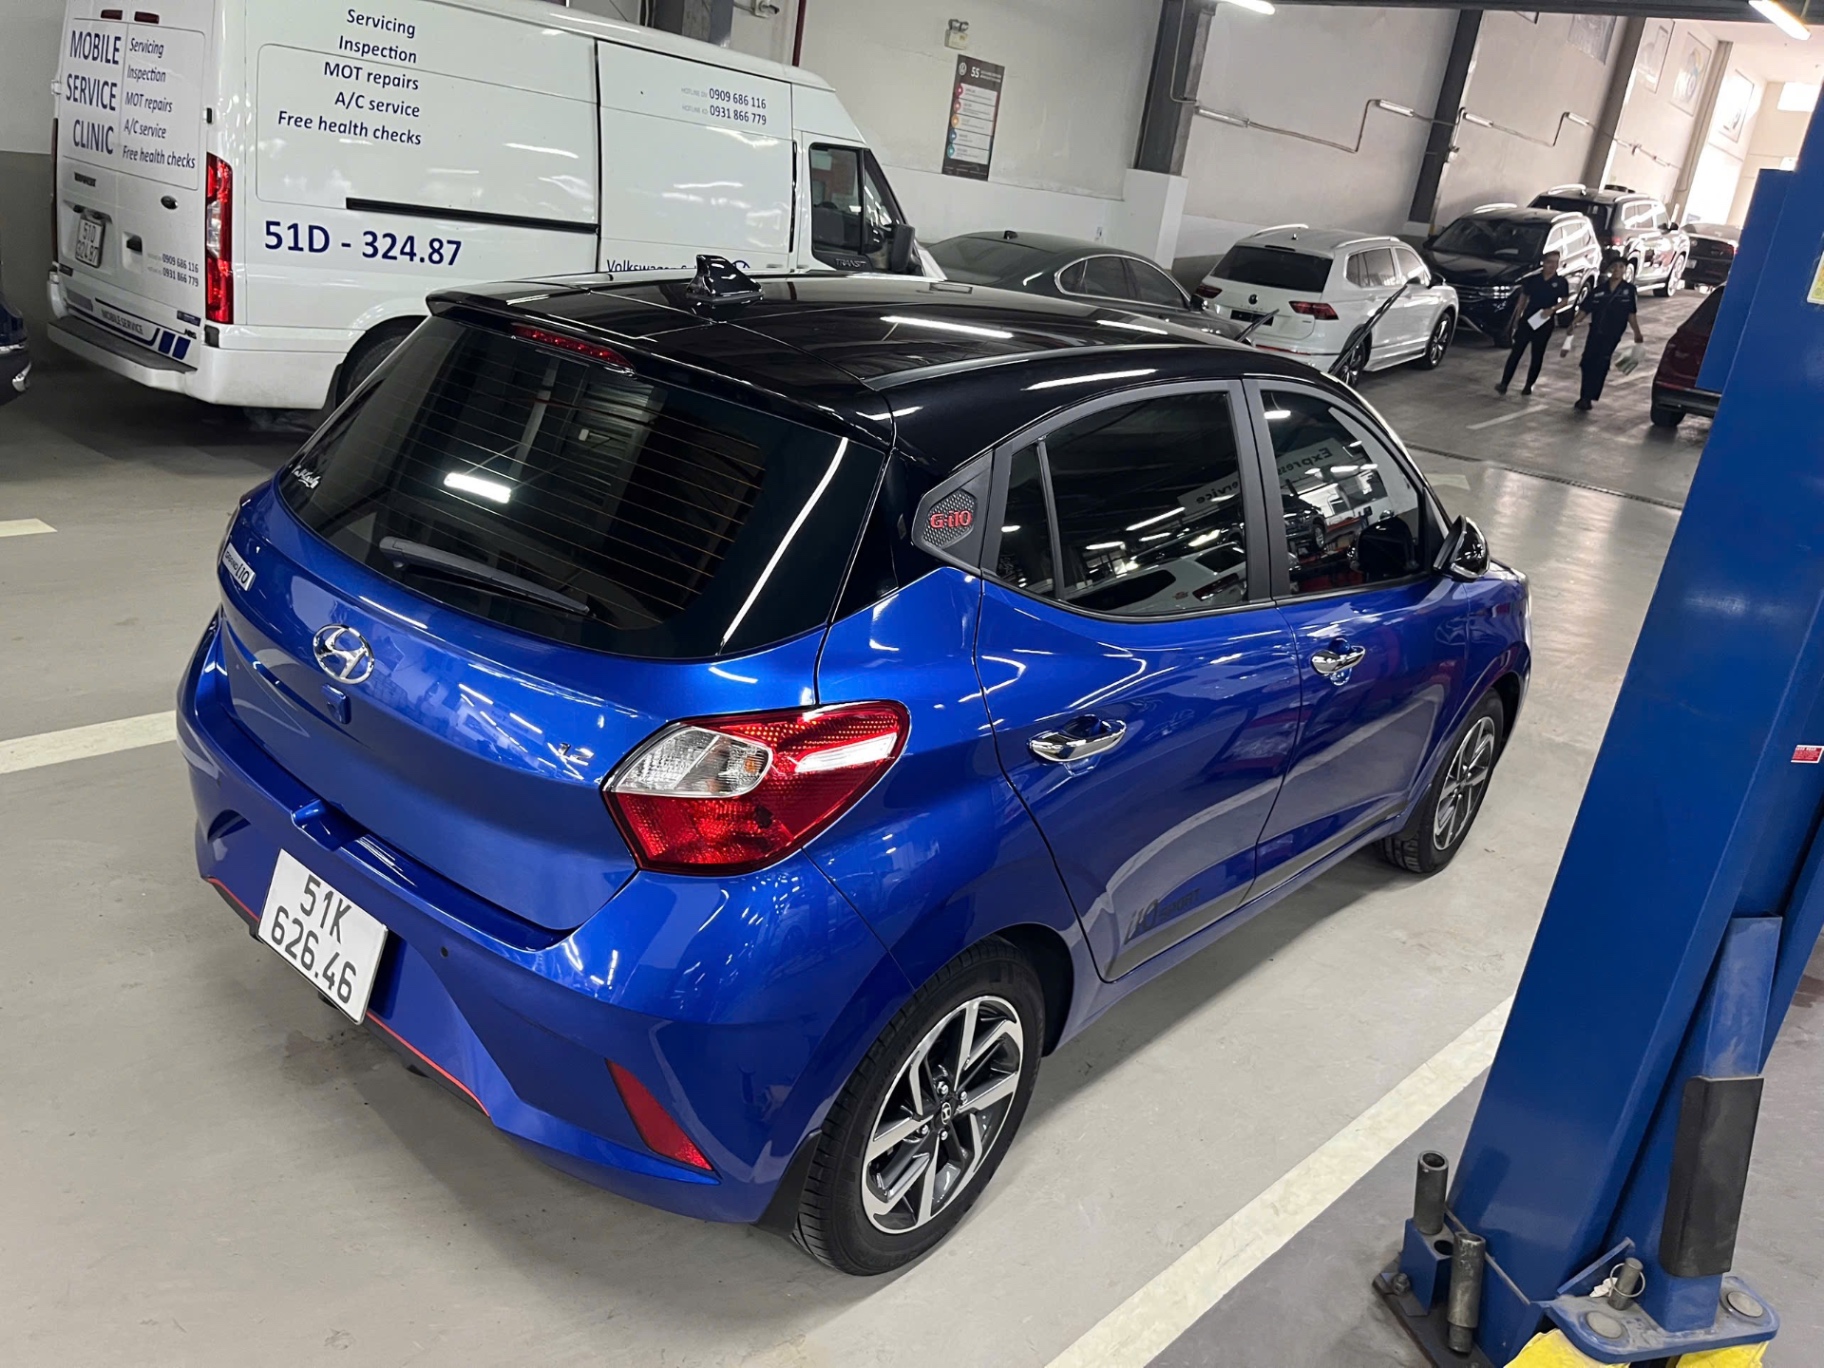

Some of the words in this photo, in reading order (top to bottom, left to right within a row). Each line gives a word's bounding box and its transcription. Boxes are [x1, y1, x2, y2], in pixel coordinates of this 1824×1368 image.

[346, 9, 416, 39] Servicing
[70, 30, 121, 65] MOBILE
[129, 37, 165, 59] Servicing
[338, 35, 417, 64] Inspection
[127, 65, 167, 83] Inspection
[324, 61, 363, 81] MOT
[366, 69, 419, 91] repairs
[66, 73, 117, 111] SERVICE
[125, 91, 145, 107] MOT
[144, 97, 173, 113] repairs
[334, 92, 365, 110] A/C
[368, 96, 420, 118] service
[709, 88, 731, 102] 0909
[732, 93, 749, 106] 686
[751, 97, 767, 109] 116
[123, 117, 140, 135] A/C
[139, 123, 167, 139] service
[278, 110, 313, 129] Free
[318, 115, 369, 138] health
[373, 124, 422, 145] checks
[710, 104, 731, 119] 0931
[733, 109, 750, 123] 866
[751, 112, 767, 125] 779
[73, 119, 114, 155] CLINIC
[122, 145, 139, 161] Free
[139, 147, 165, 165] health
[166, 151, 196, 169] checks
[264, 220, 331, 253] 51D
[362, 230, 462, 266] 324.87
[162, 253, 176, 266] 0909
[188, 261, 199, 273] 116
[162, 267, 176, 280] 0931
[188, 275, 199, 287] 779
[300, 874, 352, 945] 51K
[271, 905, 357, 1004] 626.46
